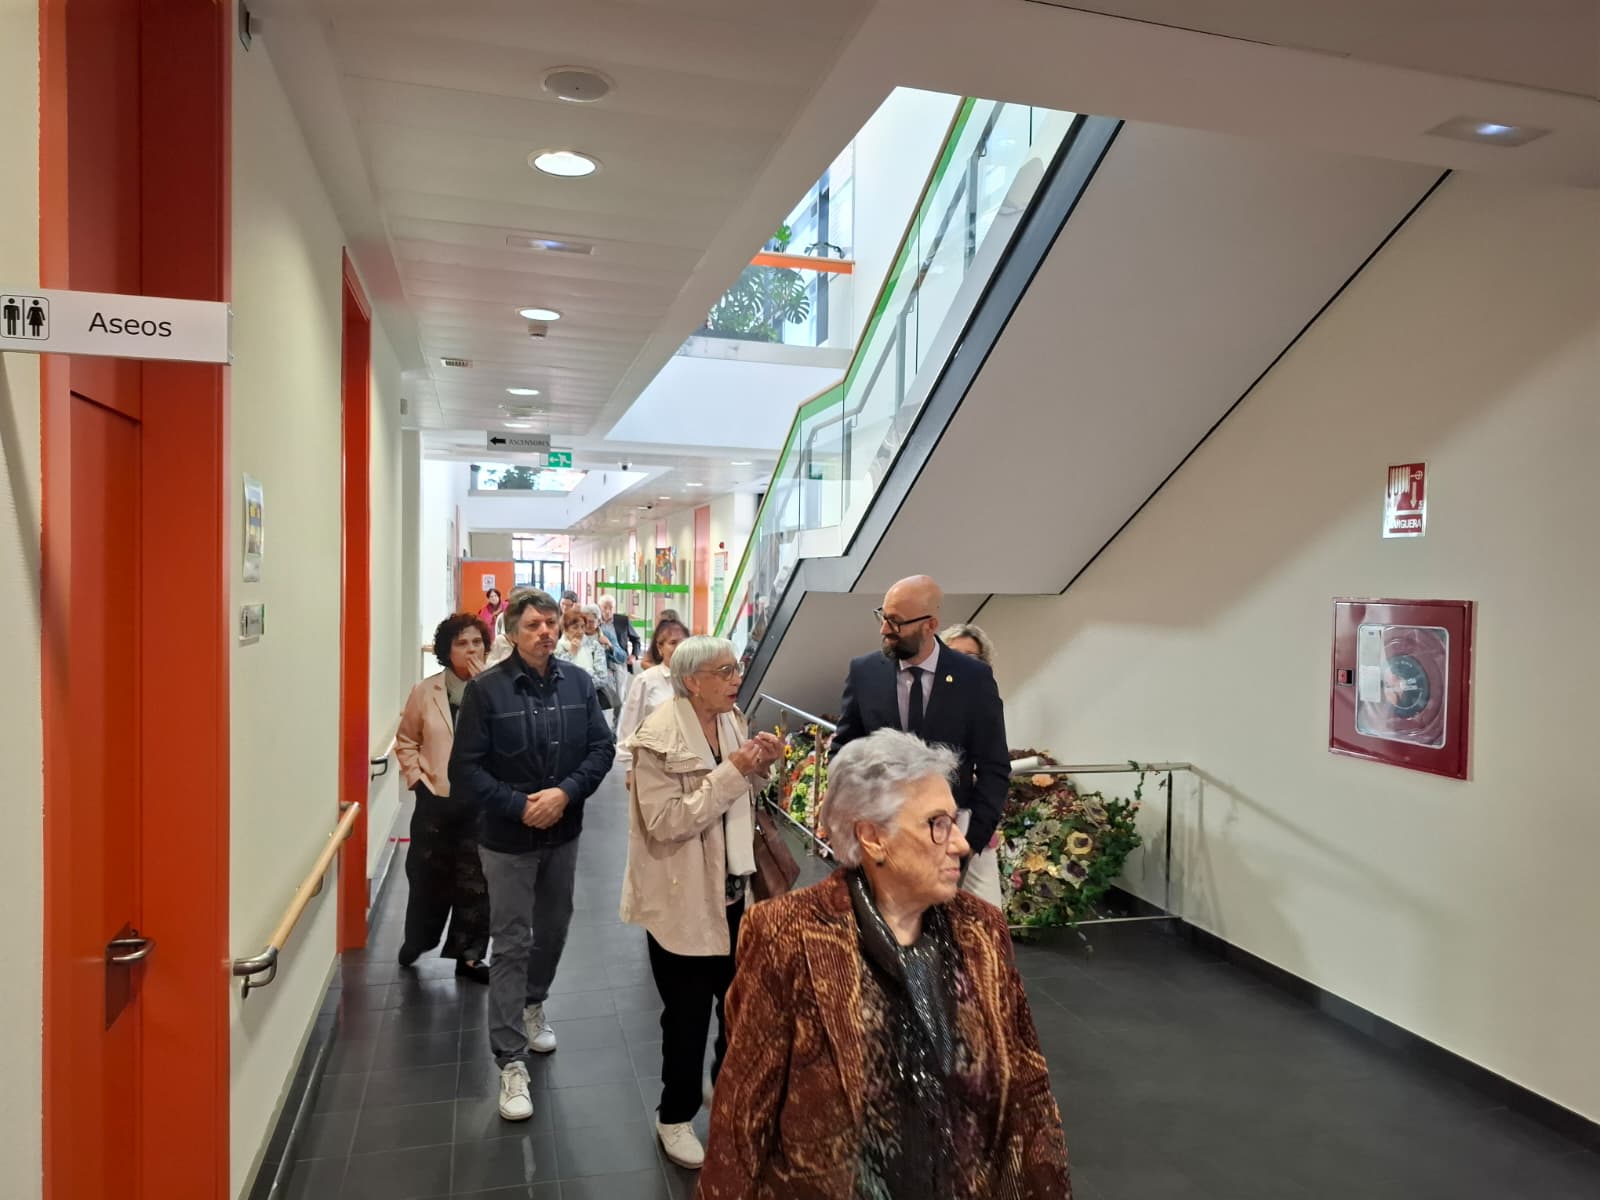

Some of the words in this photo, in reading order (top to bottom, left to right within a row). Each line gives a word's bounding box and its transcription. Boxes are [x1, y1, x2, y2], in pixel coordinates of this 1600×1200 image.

[88, 312, 172, 338] Aseos
[509, 439, 550, 447] ASCENSORES
[1389, 518, 1421, 529] ANGUERA
